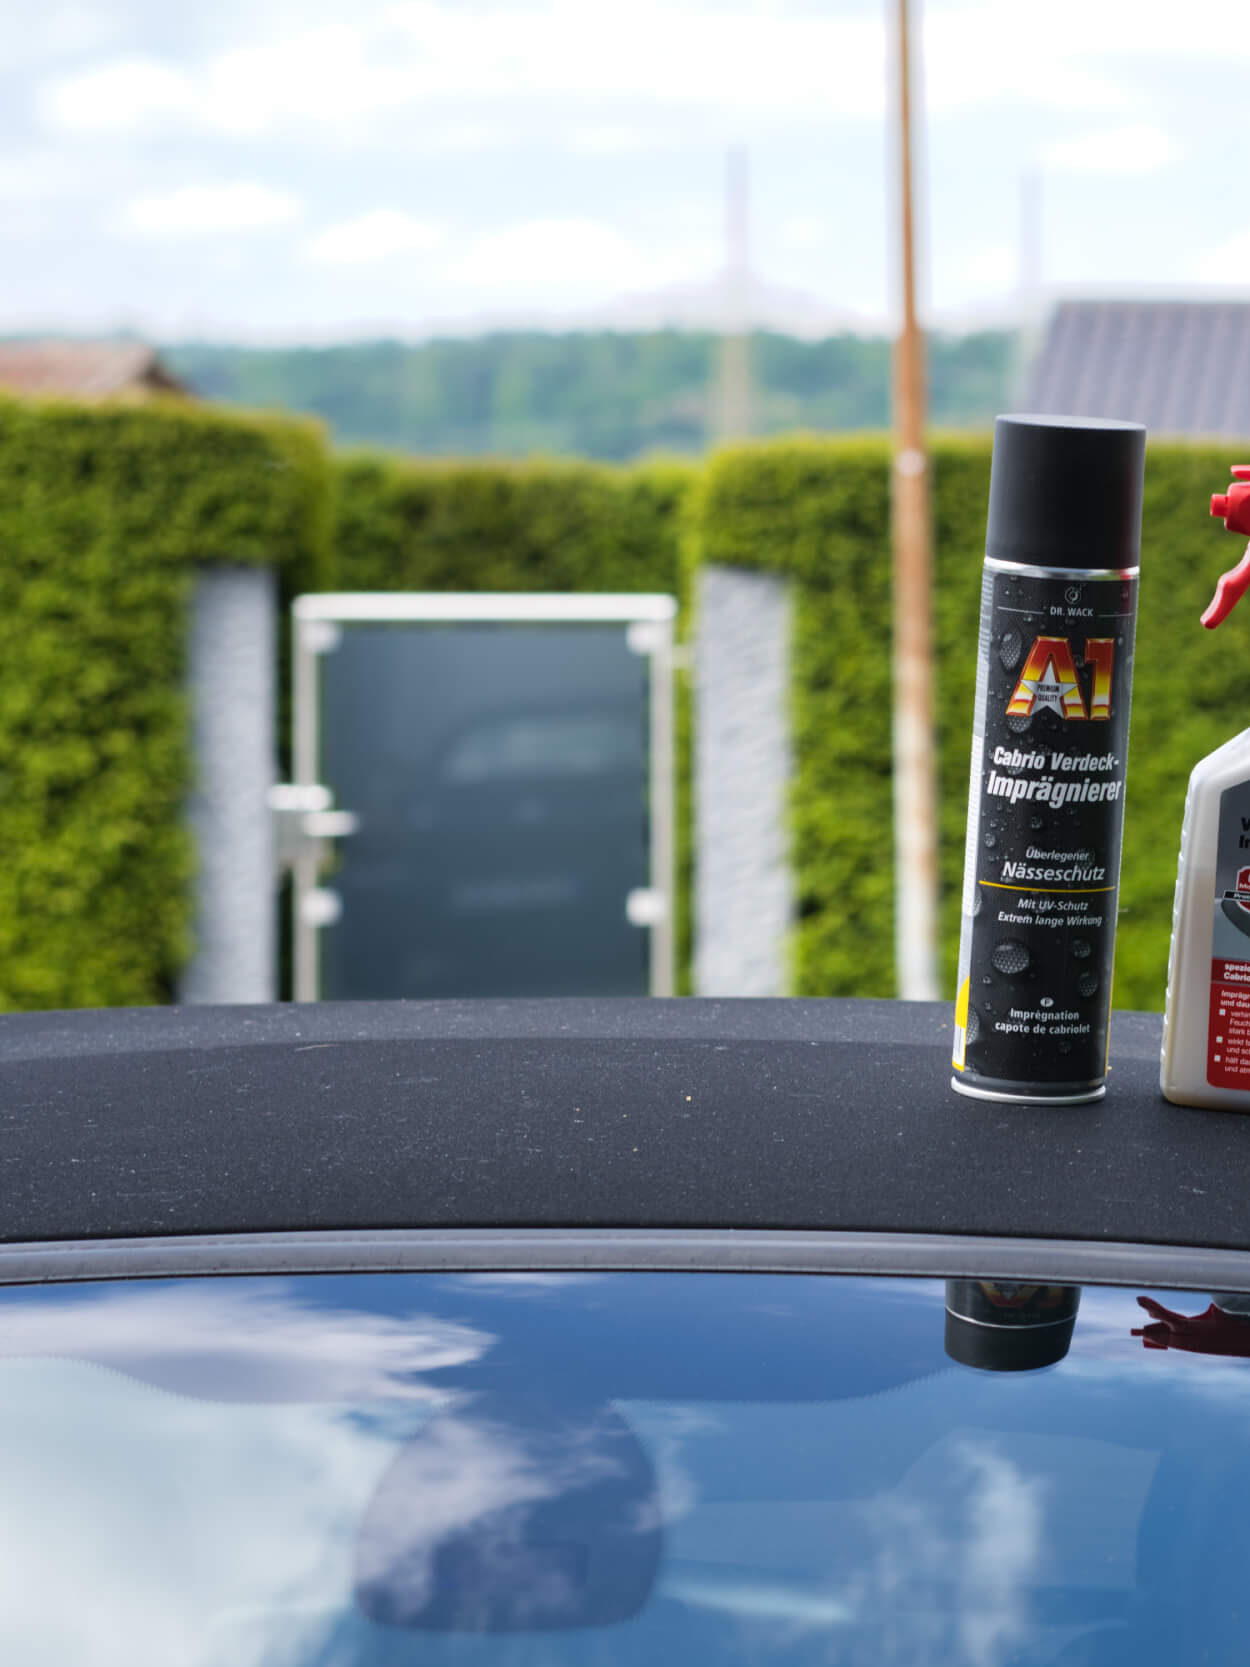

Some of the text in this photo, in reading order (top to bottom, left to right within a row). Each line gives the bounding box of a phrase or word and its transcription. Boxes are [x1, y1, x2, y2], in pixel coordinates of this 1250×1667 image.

[1050, 607, 1094, 617] DR. WACK
[1005, 635, 1115, 721] A1
[993, 746, 1119, 772] Cabrio Verdeck-
[987, 770, 1122, 809] Imprägnierer
[1025, 846, 1090, 862] Überlegener
[1002, 861, 1105, 881] Nässeschutz
[1018, 898, 1088, 912] Mit UV-Schutz
[998, 912, 1102, 928] Extrem lange Wirkung
[1010, 1008, 1079, 1021] Imprégnation
[995, 1021, 1090, 1034] capote de cabriolet
